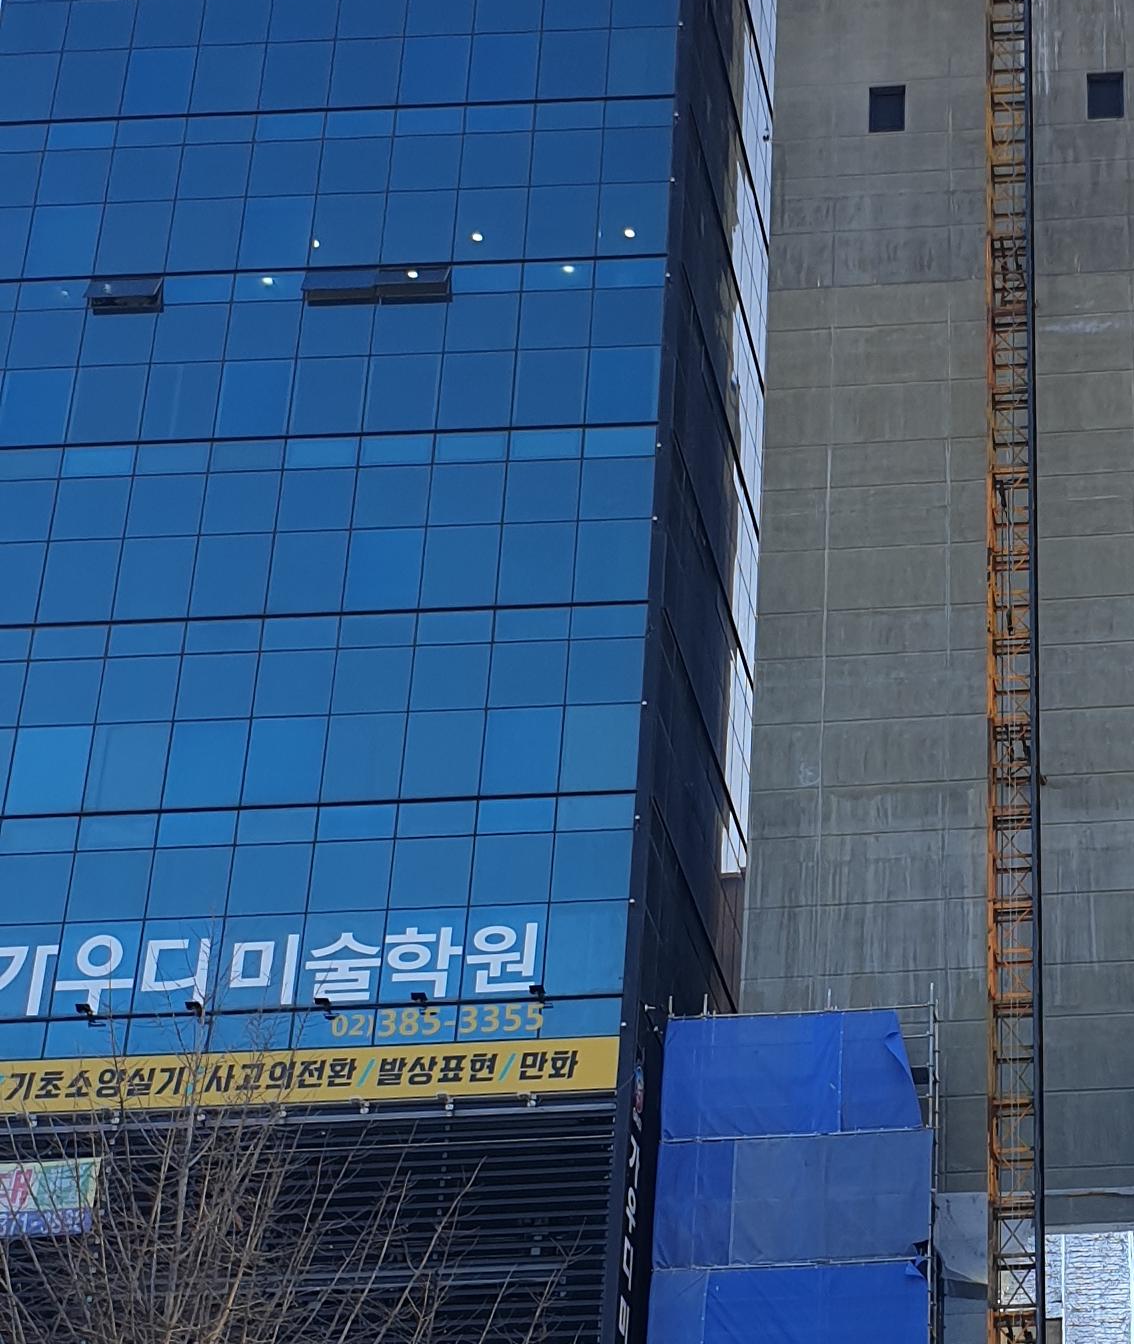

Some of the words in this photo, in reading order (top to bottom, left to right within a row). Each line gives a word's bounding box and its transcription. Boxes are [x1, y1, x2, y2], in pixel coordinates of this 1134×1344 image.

[0, 921, 539, 1016] 가우디미술학원
[331, 1004, 545, 1038] 02)385-3355
[4, 1066, 187, 1101] 기초소양실기
[204, 1057, 357, 1093] 사고의전환
[376, 1053, 499, 1086] 발상표현
[519, 1050, 579, 1081] 만화
